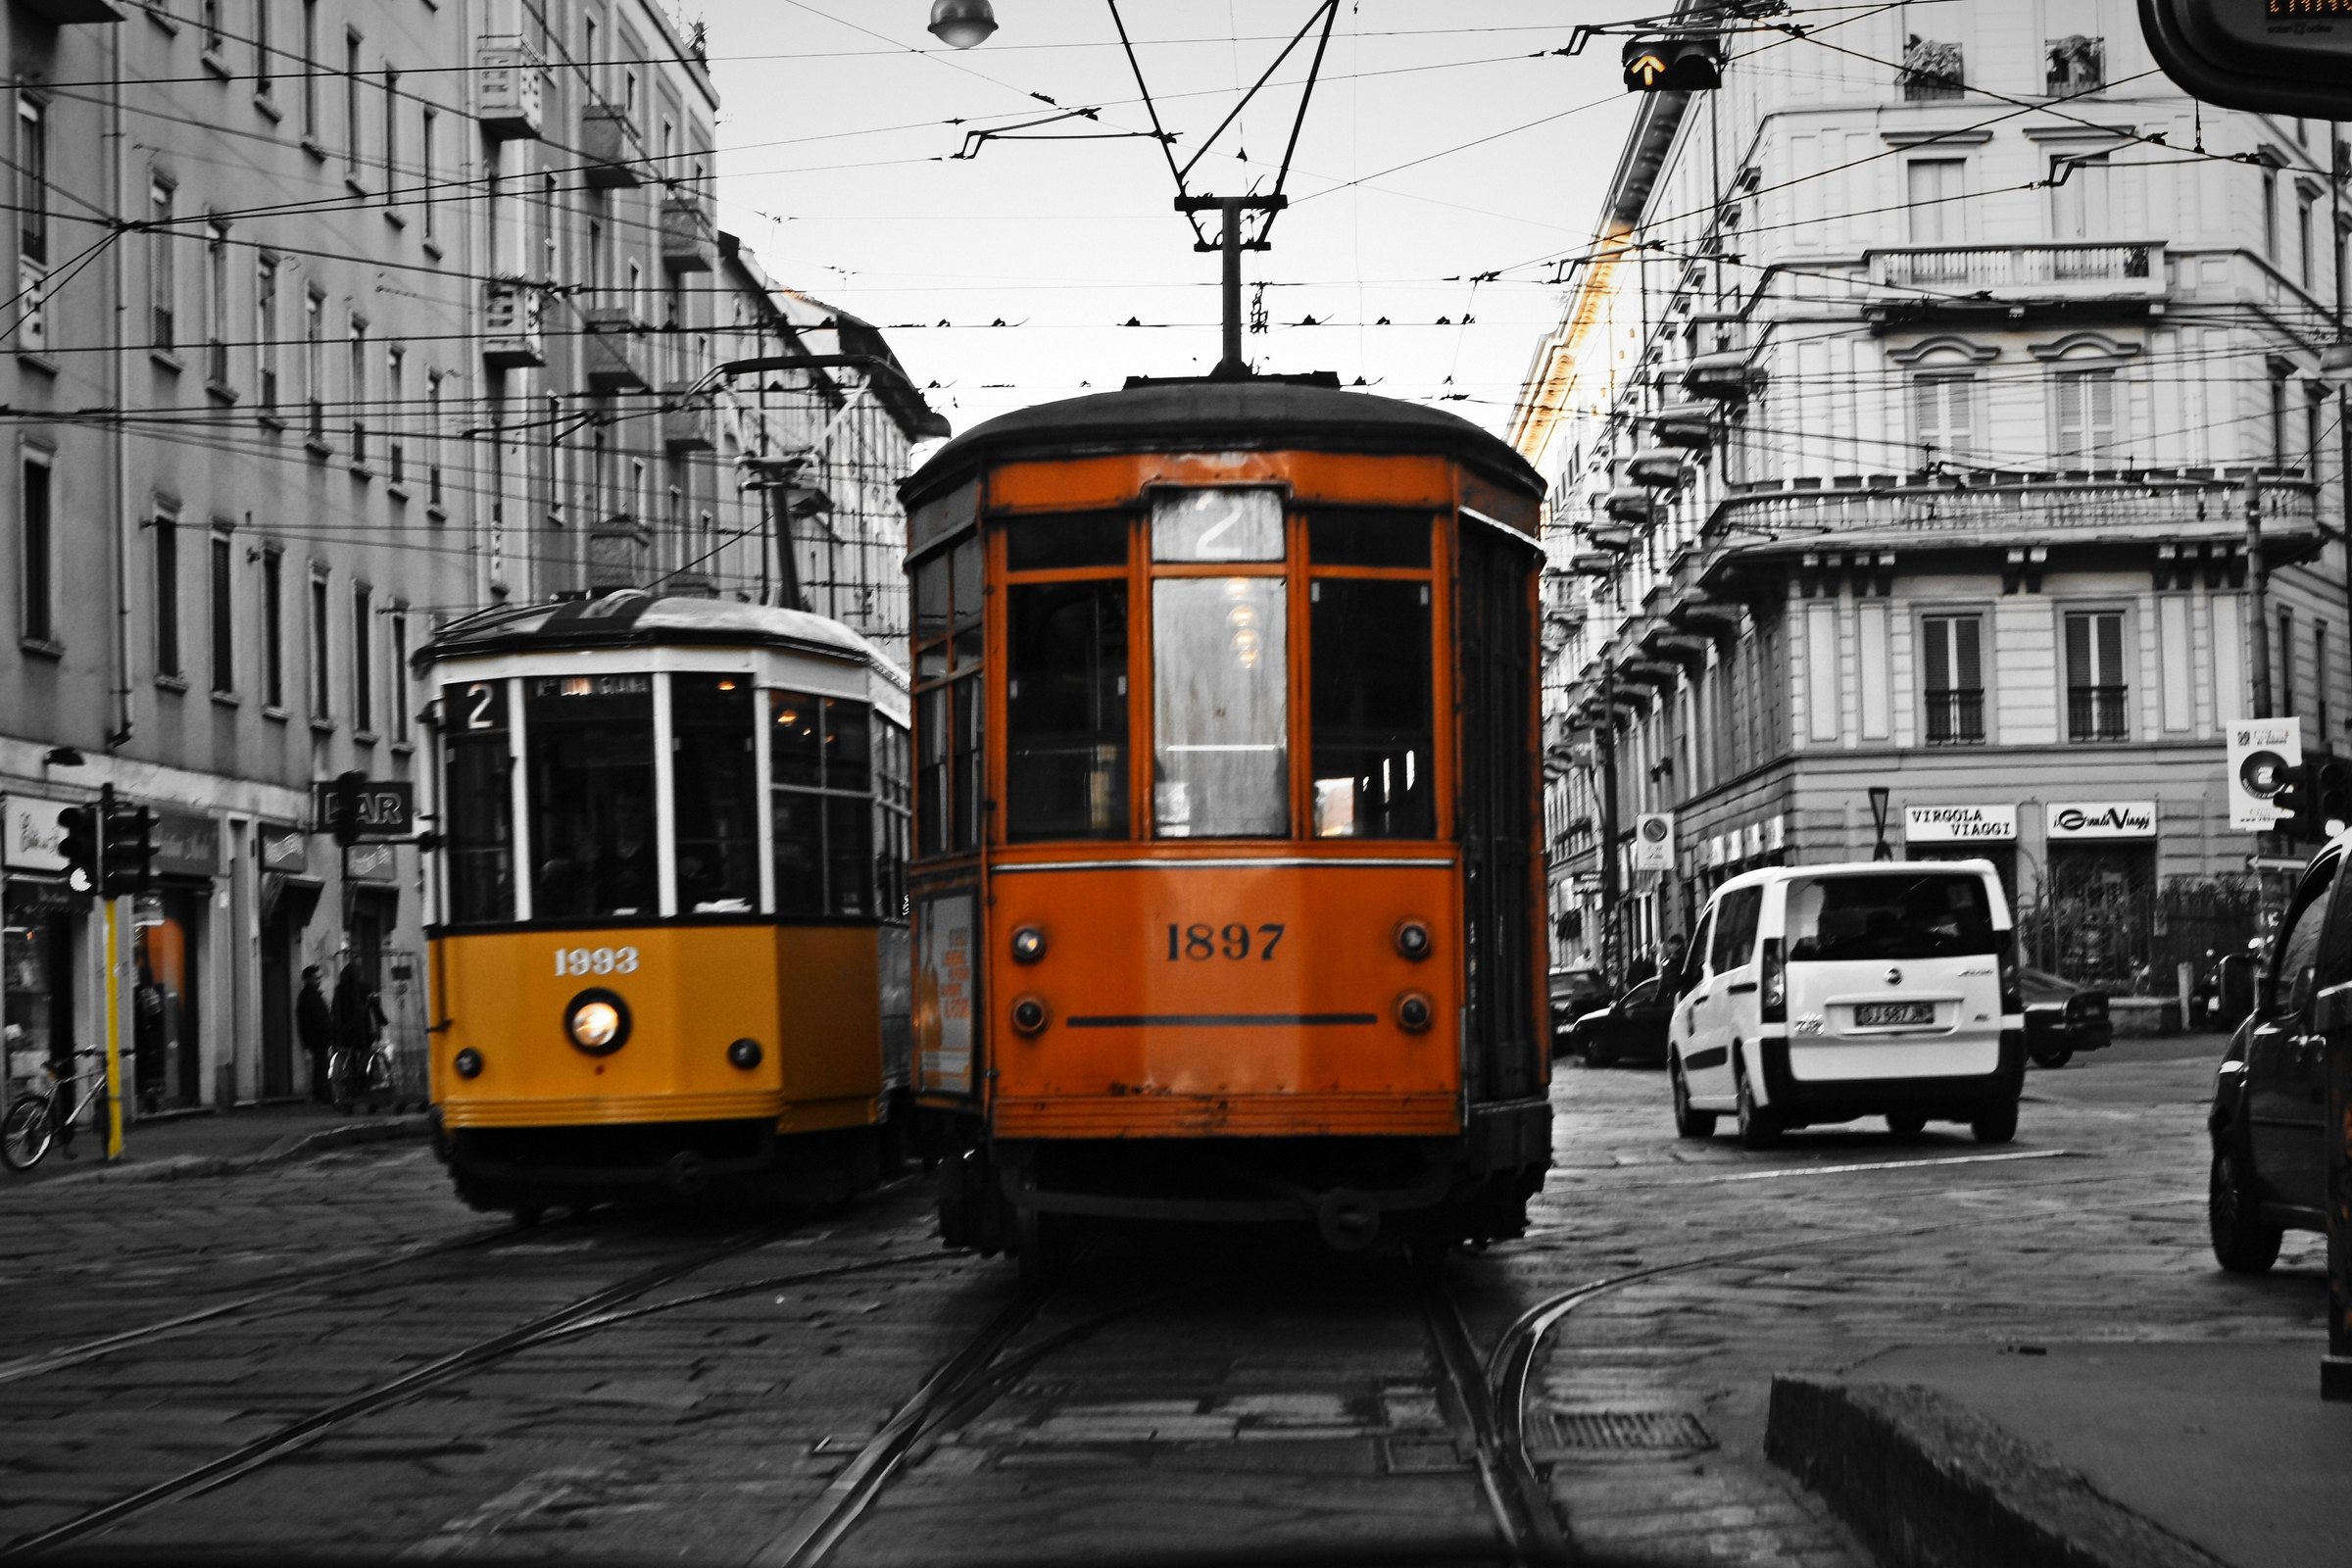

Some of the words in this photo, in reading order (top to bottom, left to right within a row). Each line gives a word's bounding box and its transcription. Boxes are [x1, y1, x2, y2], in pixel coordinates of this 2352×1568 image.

[1196, 490, 1243, 558] 2
[466, 684, 493, 729] 2
[1912, 808, 1983, 823] VIRGOLA
[1951, 822, 2011, 836] VIAGGI
[1168, 923, 1286, 960] 1897
[553, 946, 639, 976] 1993
